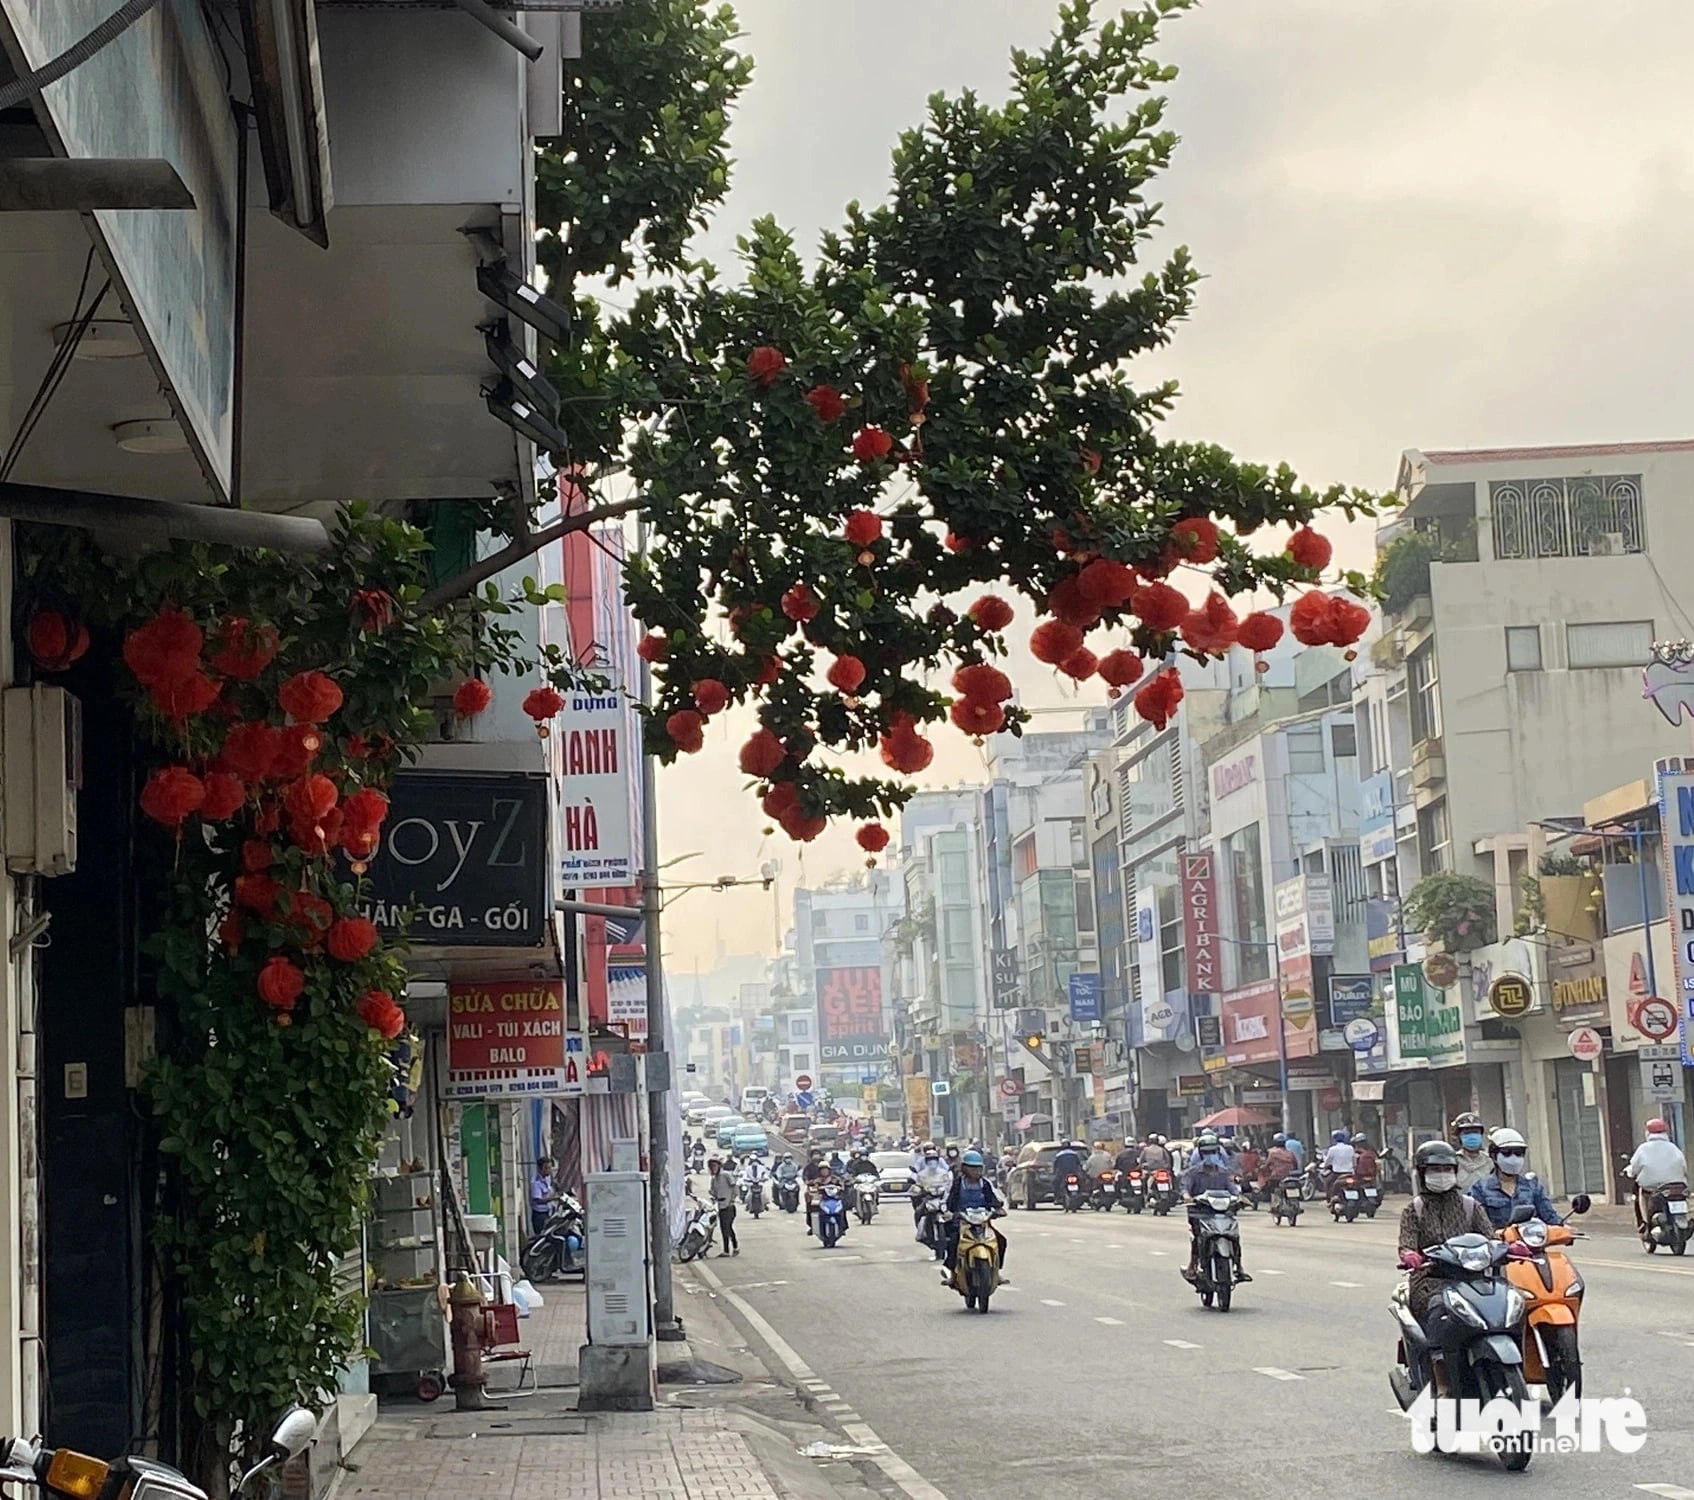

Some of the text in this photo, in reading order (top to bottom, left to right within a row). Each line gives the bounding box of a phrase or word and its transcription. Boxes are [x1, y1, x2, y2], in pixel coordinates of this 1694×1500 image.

[566, 797, 599, 851] HÀ
[429, 905, 464, 928] GA
[484, 900, 529, 931] GỐI
[1191, 881, 1213, 990] AGRIBANK
[452, 987, 560, 1013] SỬA CHỮA
[453, 1024, 483, 1039] VALI
[496, 1019, 518, 1037] TÚI
[522, 1017, 561, 1037] XÁCH
[490, 1047, 526, 1064] BALO
[821, 1045, 849, 1057] GIA
